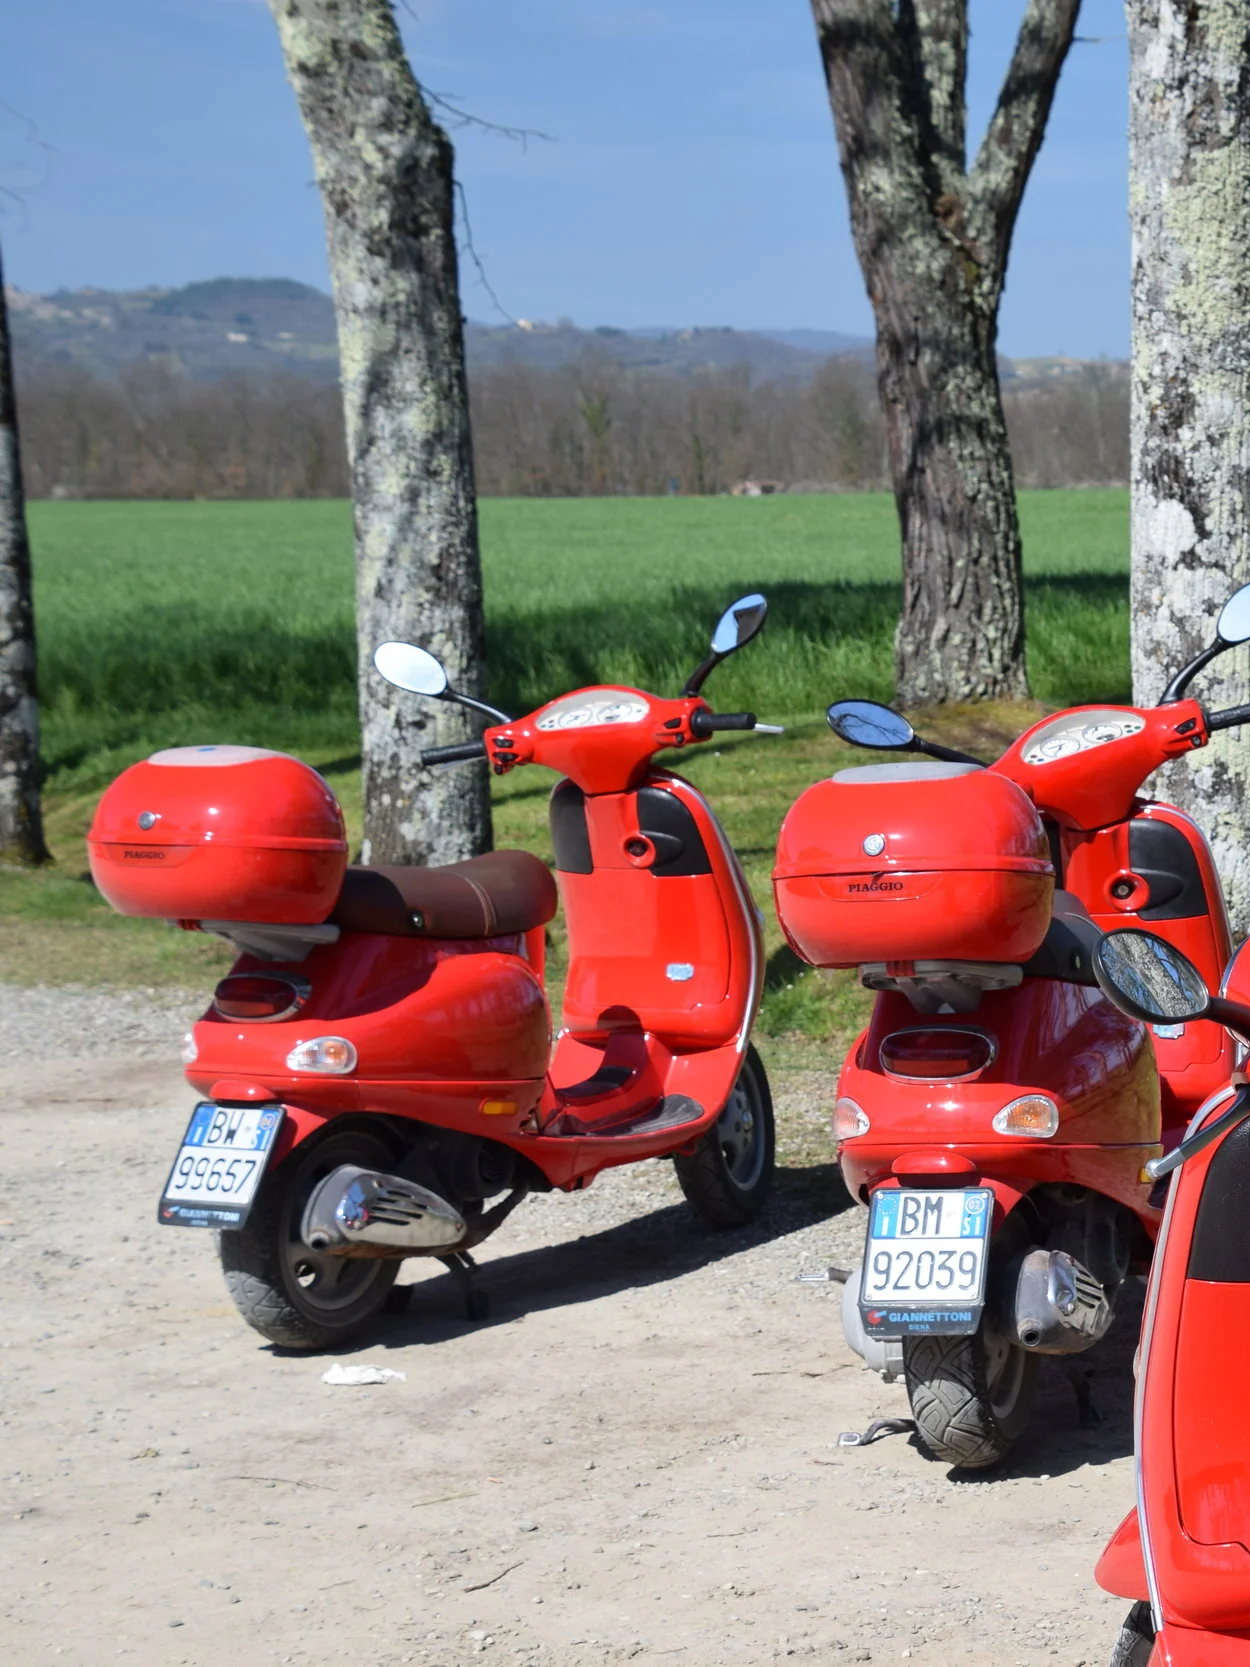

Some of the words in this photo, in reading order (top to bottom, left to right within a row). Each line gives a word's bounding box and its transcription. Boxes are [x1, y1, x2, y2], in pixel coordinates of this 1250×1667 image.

[123, 850, 166, 860] PIAGGIO
[848, 881, 904, 893] PIAGGIO
[207, 1110, 246, 1145] BW
[175, 1156, 257, 1193] 99657
[900, 1196, 944, 1236] BM
[962, 1216, 981, 1236] SI
[873, 1250, 978, 1291] 92039
[888, 1310, 972, 1323] GIANNETTONI
